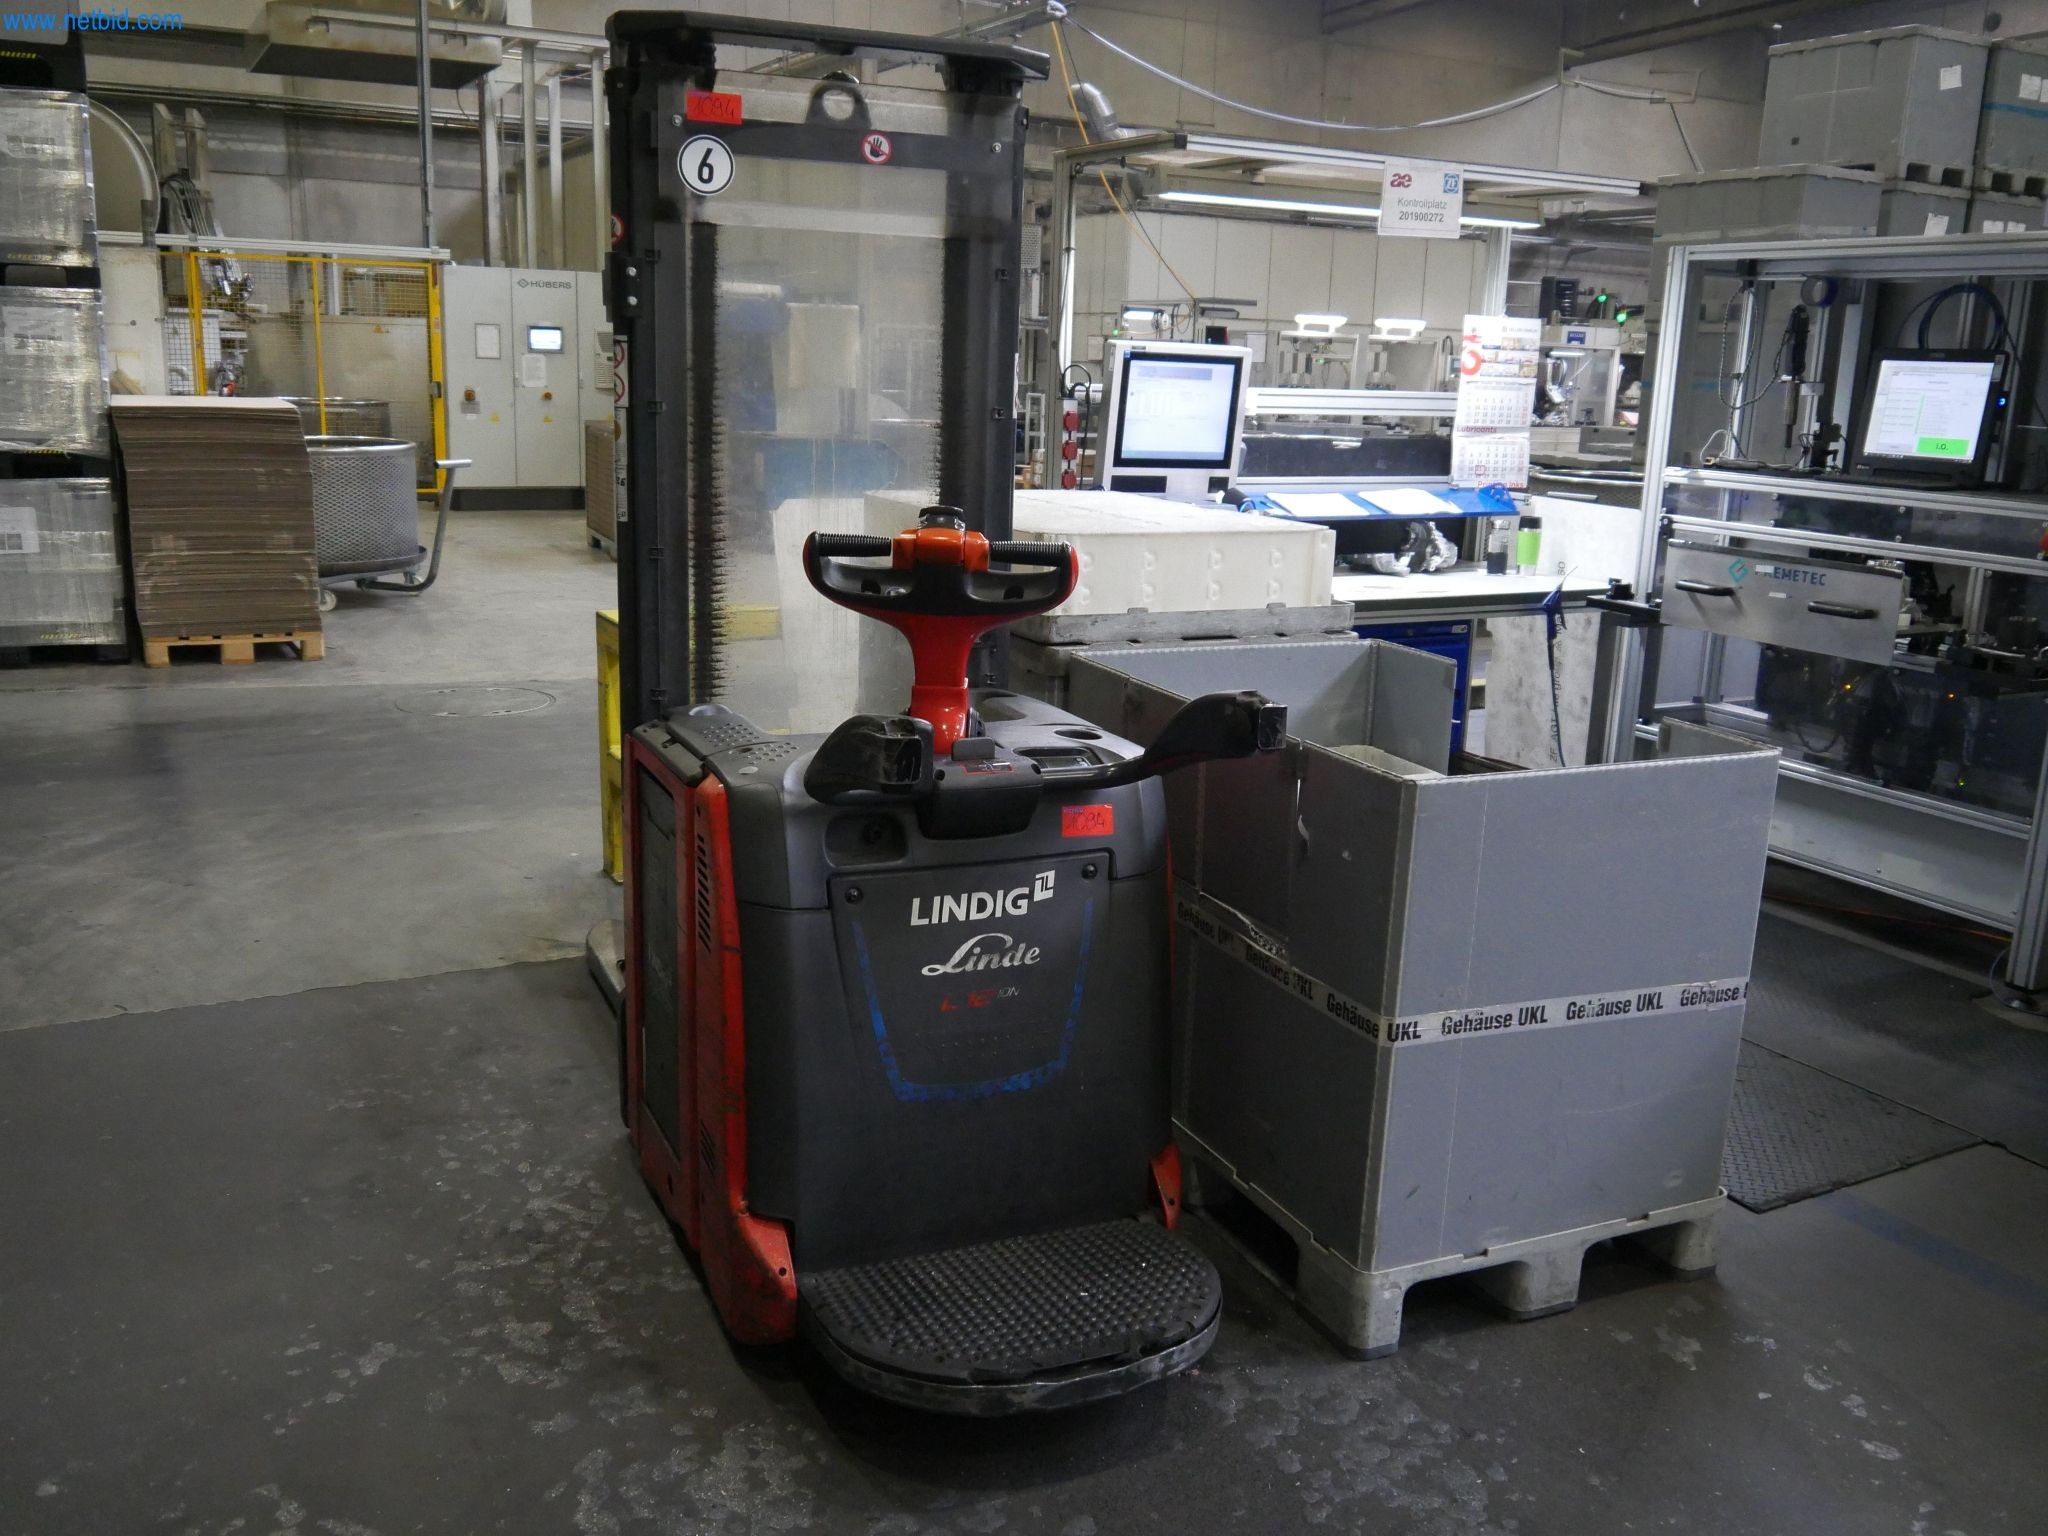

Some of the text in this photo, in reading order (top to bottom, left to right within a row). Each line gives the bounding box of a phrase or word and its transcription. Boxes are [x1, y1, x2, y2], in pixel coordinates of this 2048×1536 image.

[697, 147, 714, 185] 6
[1399, 211, 1445, 223] 201900272
[530, 280, 571, 289] HÜBERS
[910, 887, 1030, 926] LINDIG
[921, 932, 1041, 976] Linde
[1326, 993, 1380, 1040] Gehäuse
[1387, 1020, 1422, 1042] UKL
[1441, 1010, 1513, 1036] Gehäuse
[1518, 1005, 1549, 1026] UKL
[1566, 997, 1632, 1021] Gehäuse
[1636, 991, 1665, 1013] UKL
